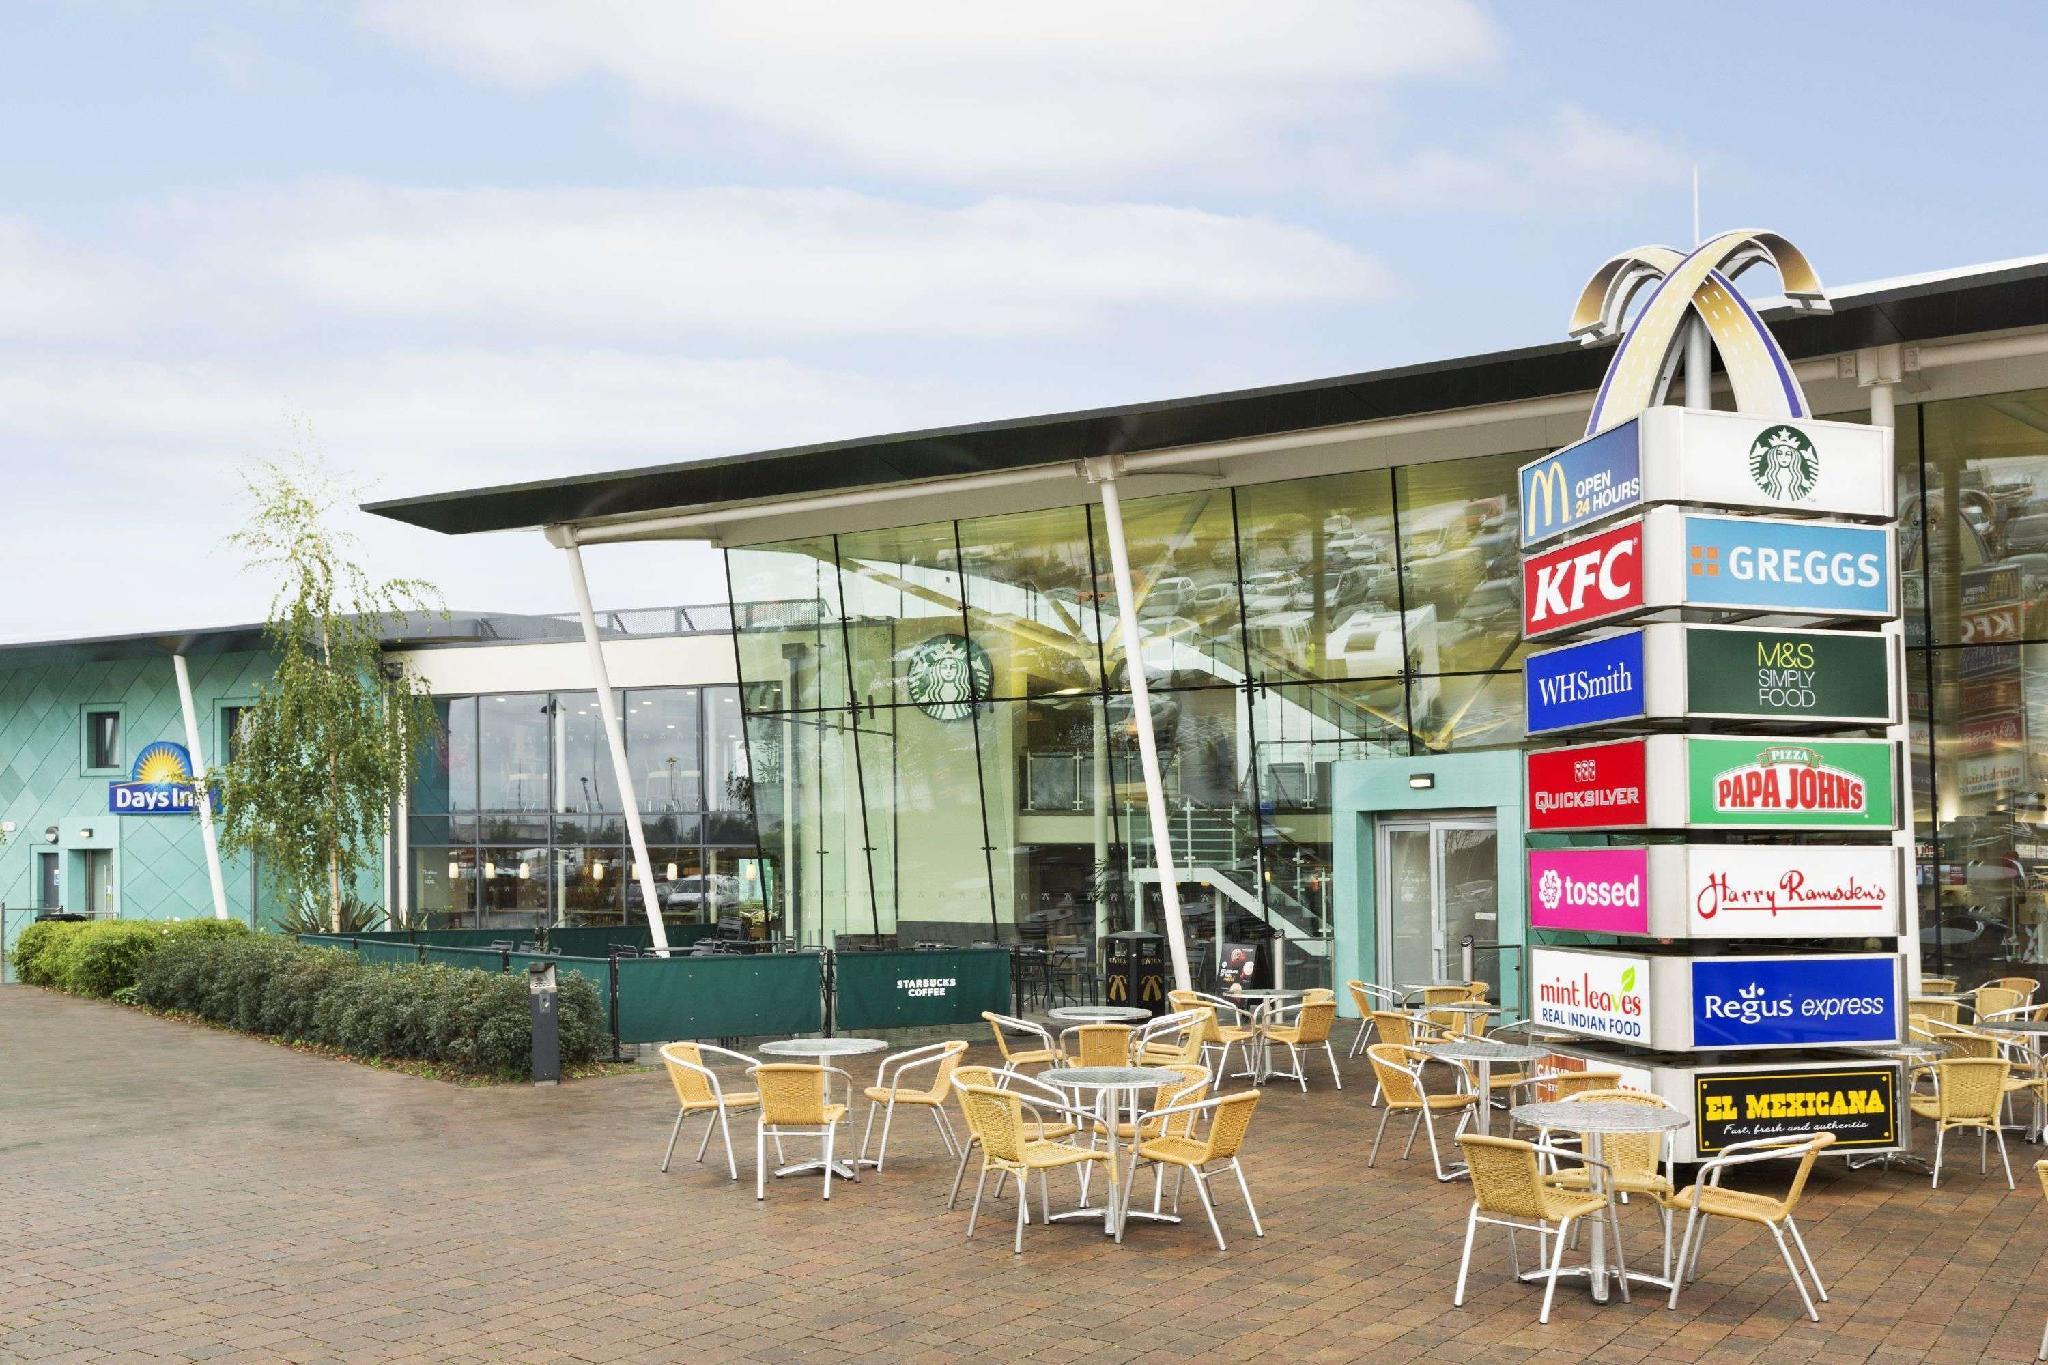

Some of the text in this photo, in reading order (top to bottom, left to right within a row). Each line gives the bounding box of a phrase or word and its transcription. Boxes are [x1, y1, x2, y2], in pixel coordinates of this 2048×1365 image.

[1575, 477, 1640, 518] 24 HOURS
[1576, 469, 1611, 499] OPEN
[1531, 539, 1634, 622] KFC
[1728, 546, 1880, 588] GREGGS
[1758, 641, 1815, 669] M&S
[1539, 662, 1633, 707] WHSmith
[1758, 668, 1816, 688] SIMPLY
[1758, 688, 1816, 707] FOOD
[1771, 750, 1809, 761] PIZZA
[116, 787, 170, 810] Days
[1535, 787, 1640, 814] QUICKSILVER
[1719, 768, 1781, 808] PAPA
[1565, 874, 1639, 907] tossed
[1697, 869, 1886, 919] Harry Ramsden's
[896, 978, 957, 989] STARBUCKS
[908, 987, 946, 997] COFFEE
[1541, 972, 1641, 1016] mint leaves
[1542, 1007, 1641, 1037] REAL INDIAN FOOD
[1704, 995, 1884, 1024] Regus express
[1706, 1090, 1885, 1121] EL MEXICANA
[1753, 1123, 1785, 1135] fresh
[1788, 1122, 1811, 1132] and
[1813, 1119, 1869, 1131] authentic
